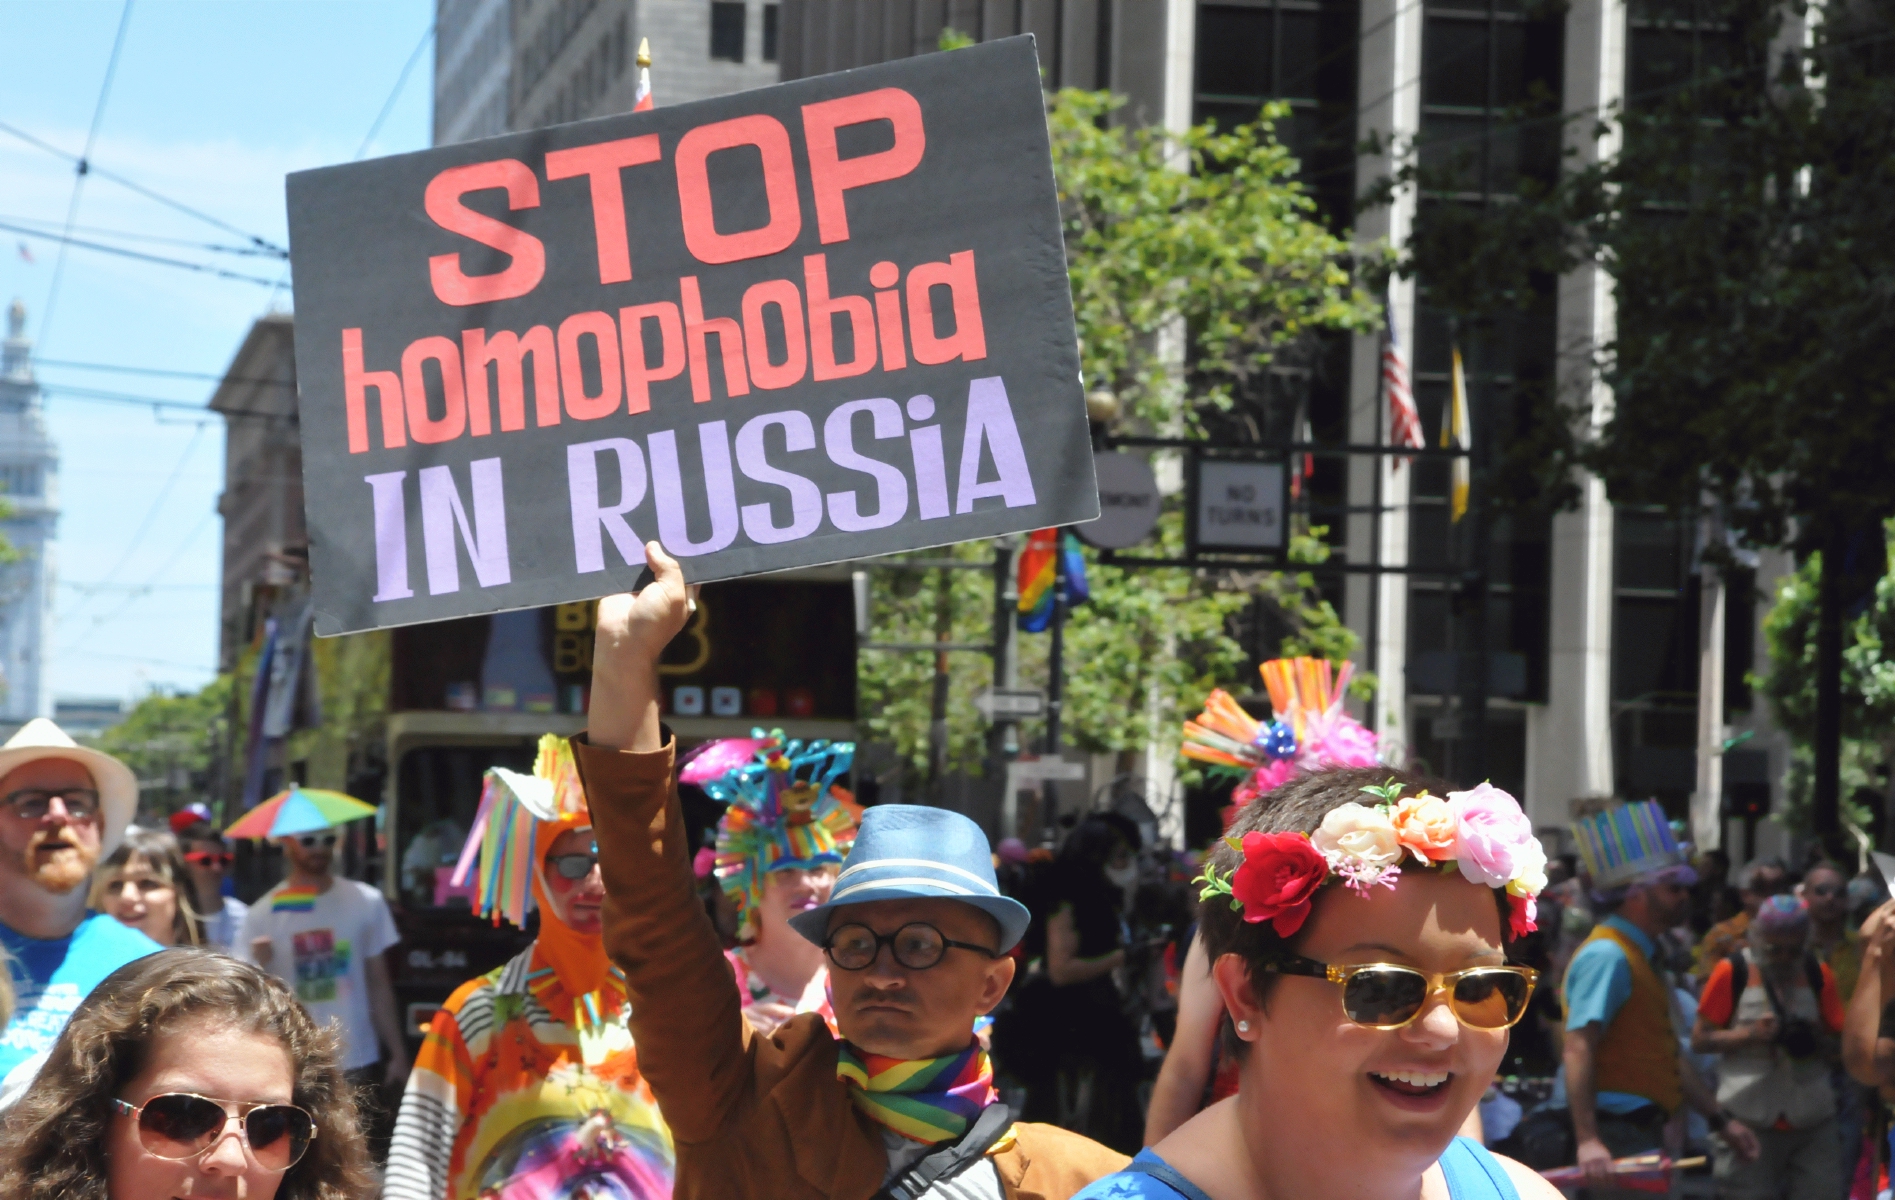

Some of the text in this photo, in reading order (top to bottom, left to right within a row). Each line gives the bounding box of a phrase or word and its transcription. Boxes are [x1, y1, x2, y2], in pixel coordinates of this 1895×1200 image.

[424, 87, 926, 307] STOP
[341, 249, 987, 455] homophobia
[364, 457, 512, 603] IN
[1208, 506, 1275, 527] TURNS
[1227, 484, 1255, 502] NO
